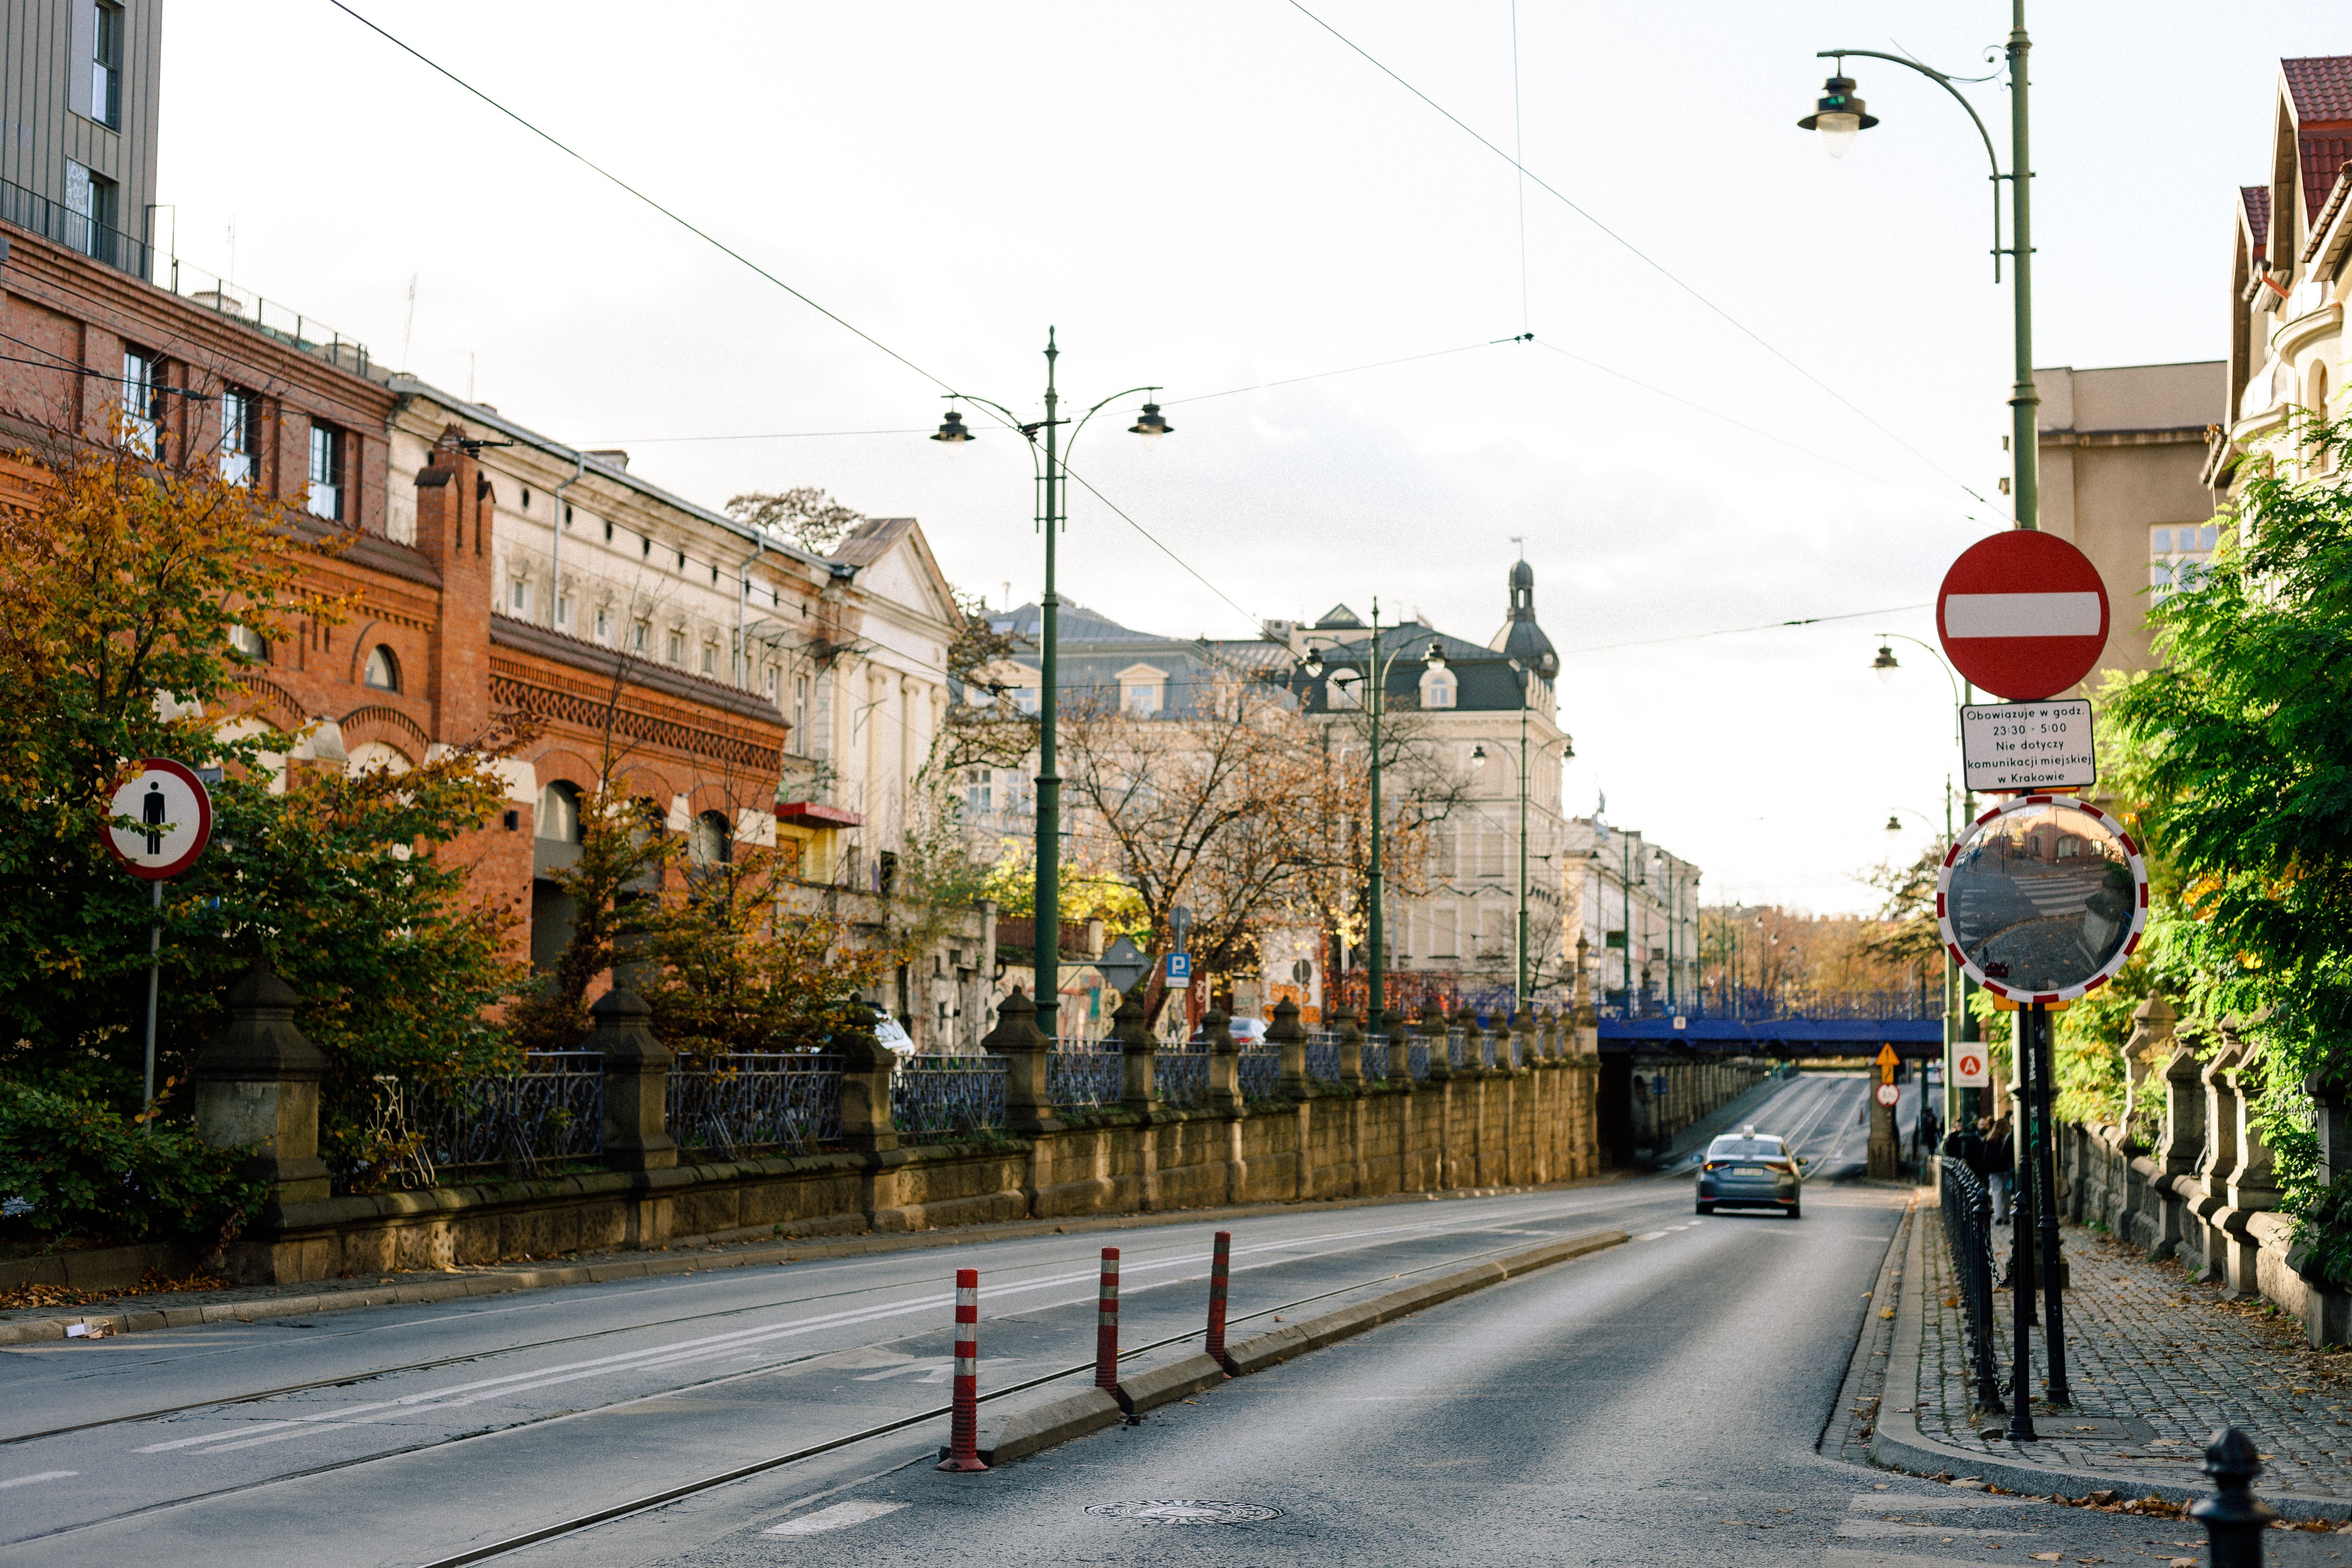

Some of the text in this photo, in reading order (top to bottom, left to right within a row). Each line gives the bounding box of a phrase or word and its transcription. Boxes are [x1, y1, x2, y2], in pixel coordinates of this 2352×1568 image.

[1967, 708, 2035, 721] Obowiązuje
[2053, 706, 2084, 718] godz.
[1994, 725, 2025, 735] 23:30
[2041, 723, 2066, 733] 5:00
[1996, 740, 2063, 751] Nie dotyczy
[1968, 754, 2091, 769] komunikacji miejskiej
[2012, 771, 2064, 782] Krakowie
[1172, 956, 1185, 975] P
[1964, 1057, 1977, 1073] A
